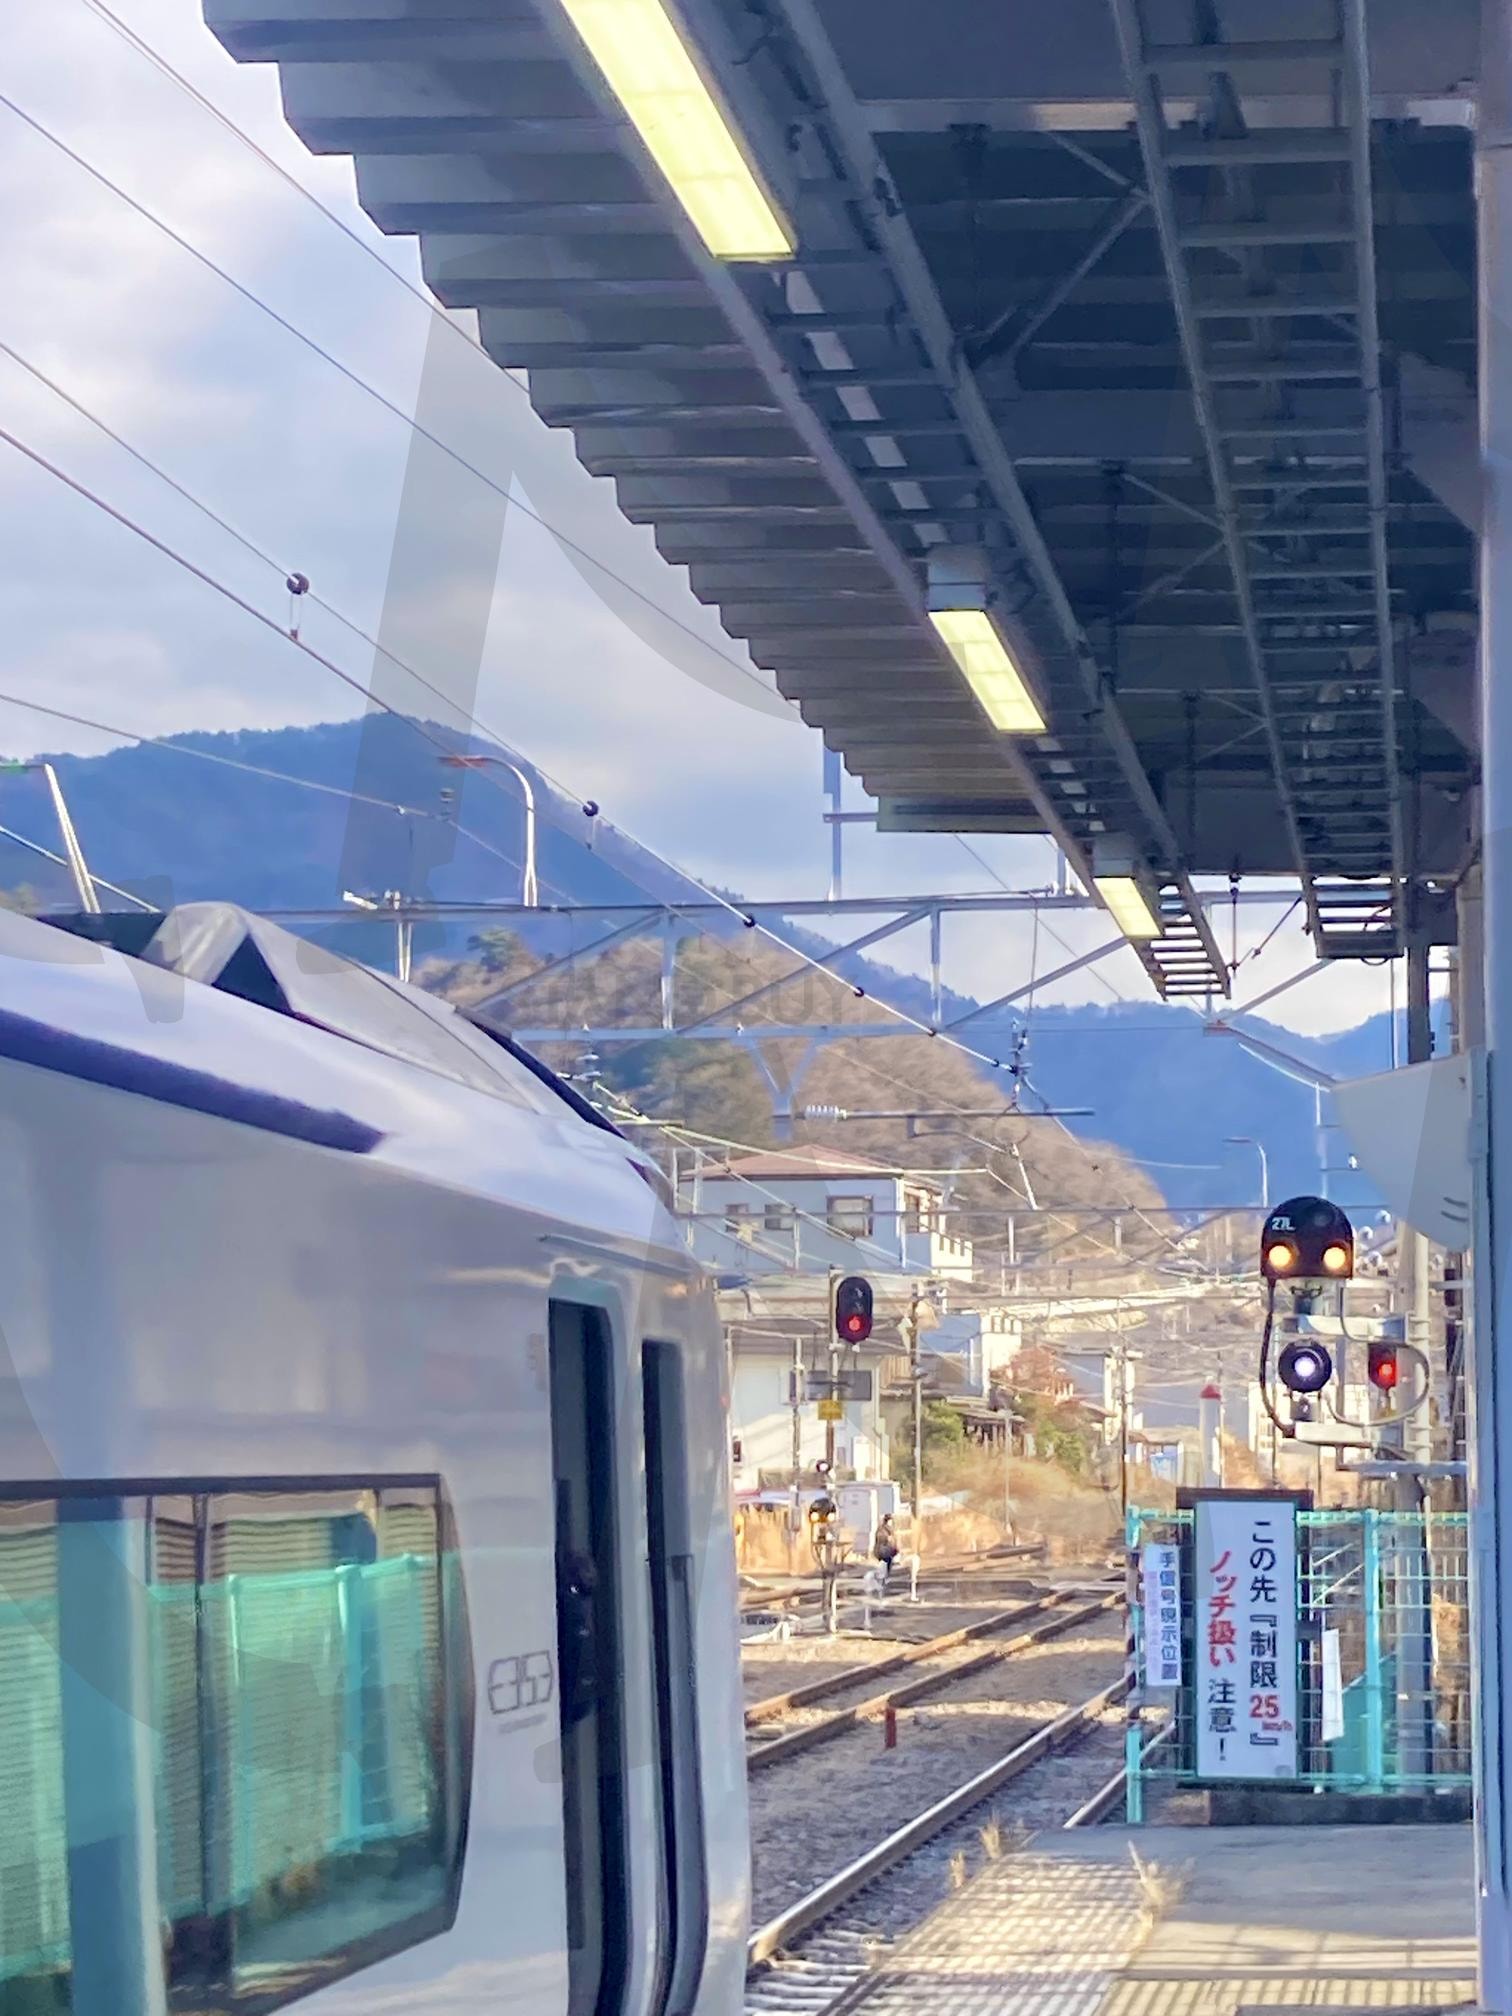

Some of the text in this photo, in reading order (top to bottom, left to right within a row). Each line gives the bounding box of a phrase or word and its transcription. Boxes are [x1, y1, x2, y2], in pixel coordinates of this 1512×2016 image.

[1207, 1550, 1238, 1667] ノッチ扱い
